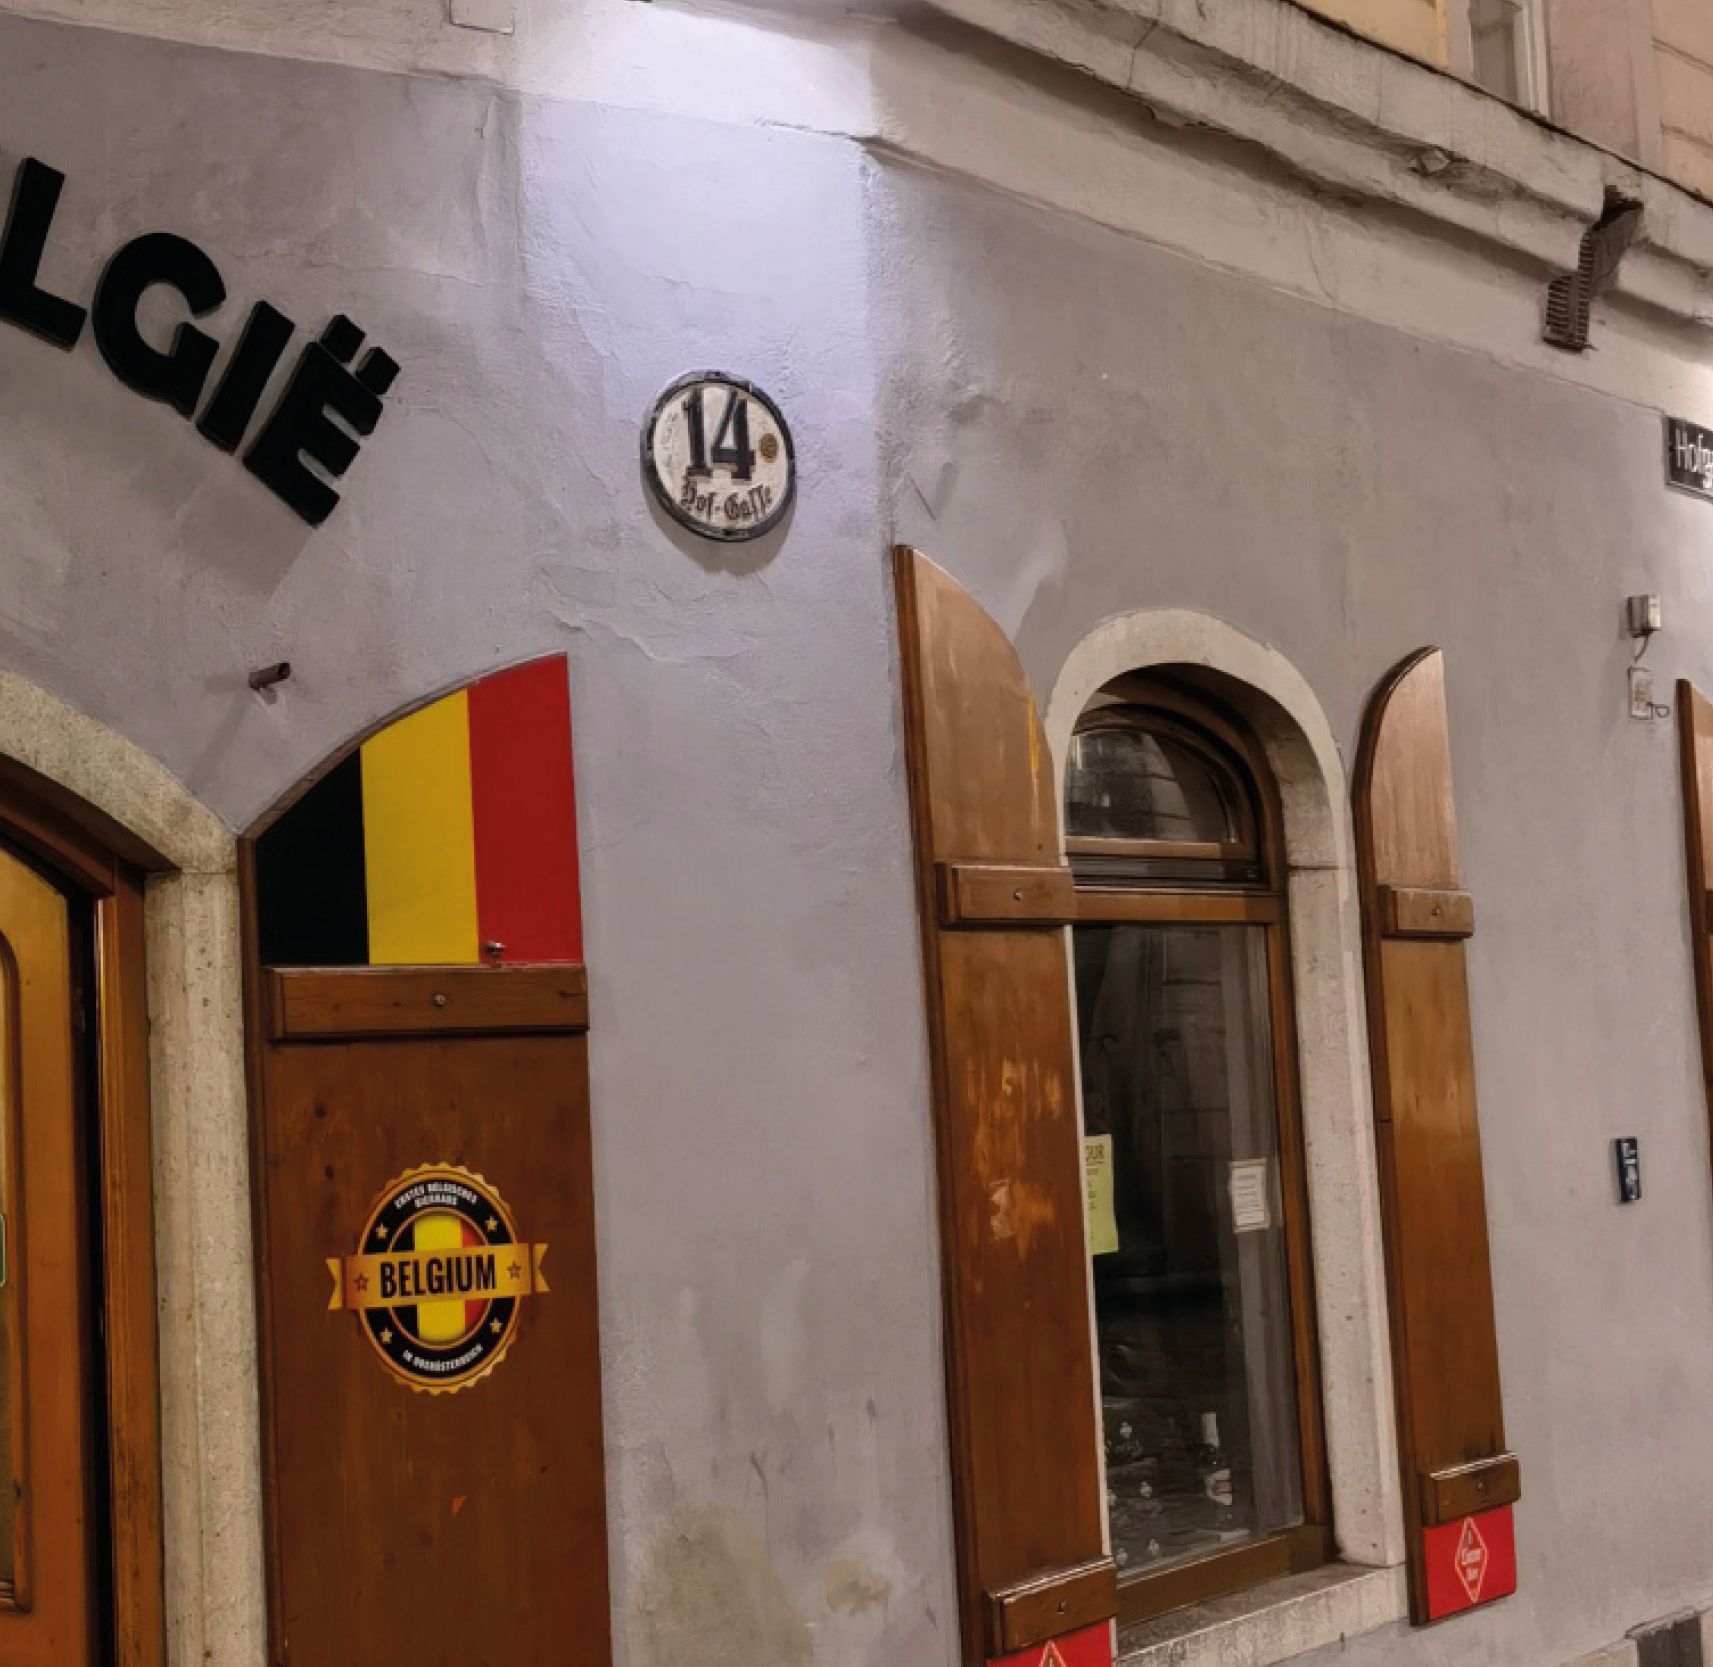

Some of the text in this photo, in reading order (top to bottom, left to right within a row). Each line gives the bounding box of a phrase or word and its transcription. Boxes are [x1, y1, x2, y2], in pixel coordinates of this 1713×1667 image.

[681, 388, 756, 480] 14
[1675, 428, 1713, 489] Hofg
[380, 1254, 497, 1299] BELGIUM
